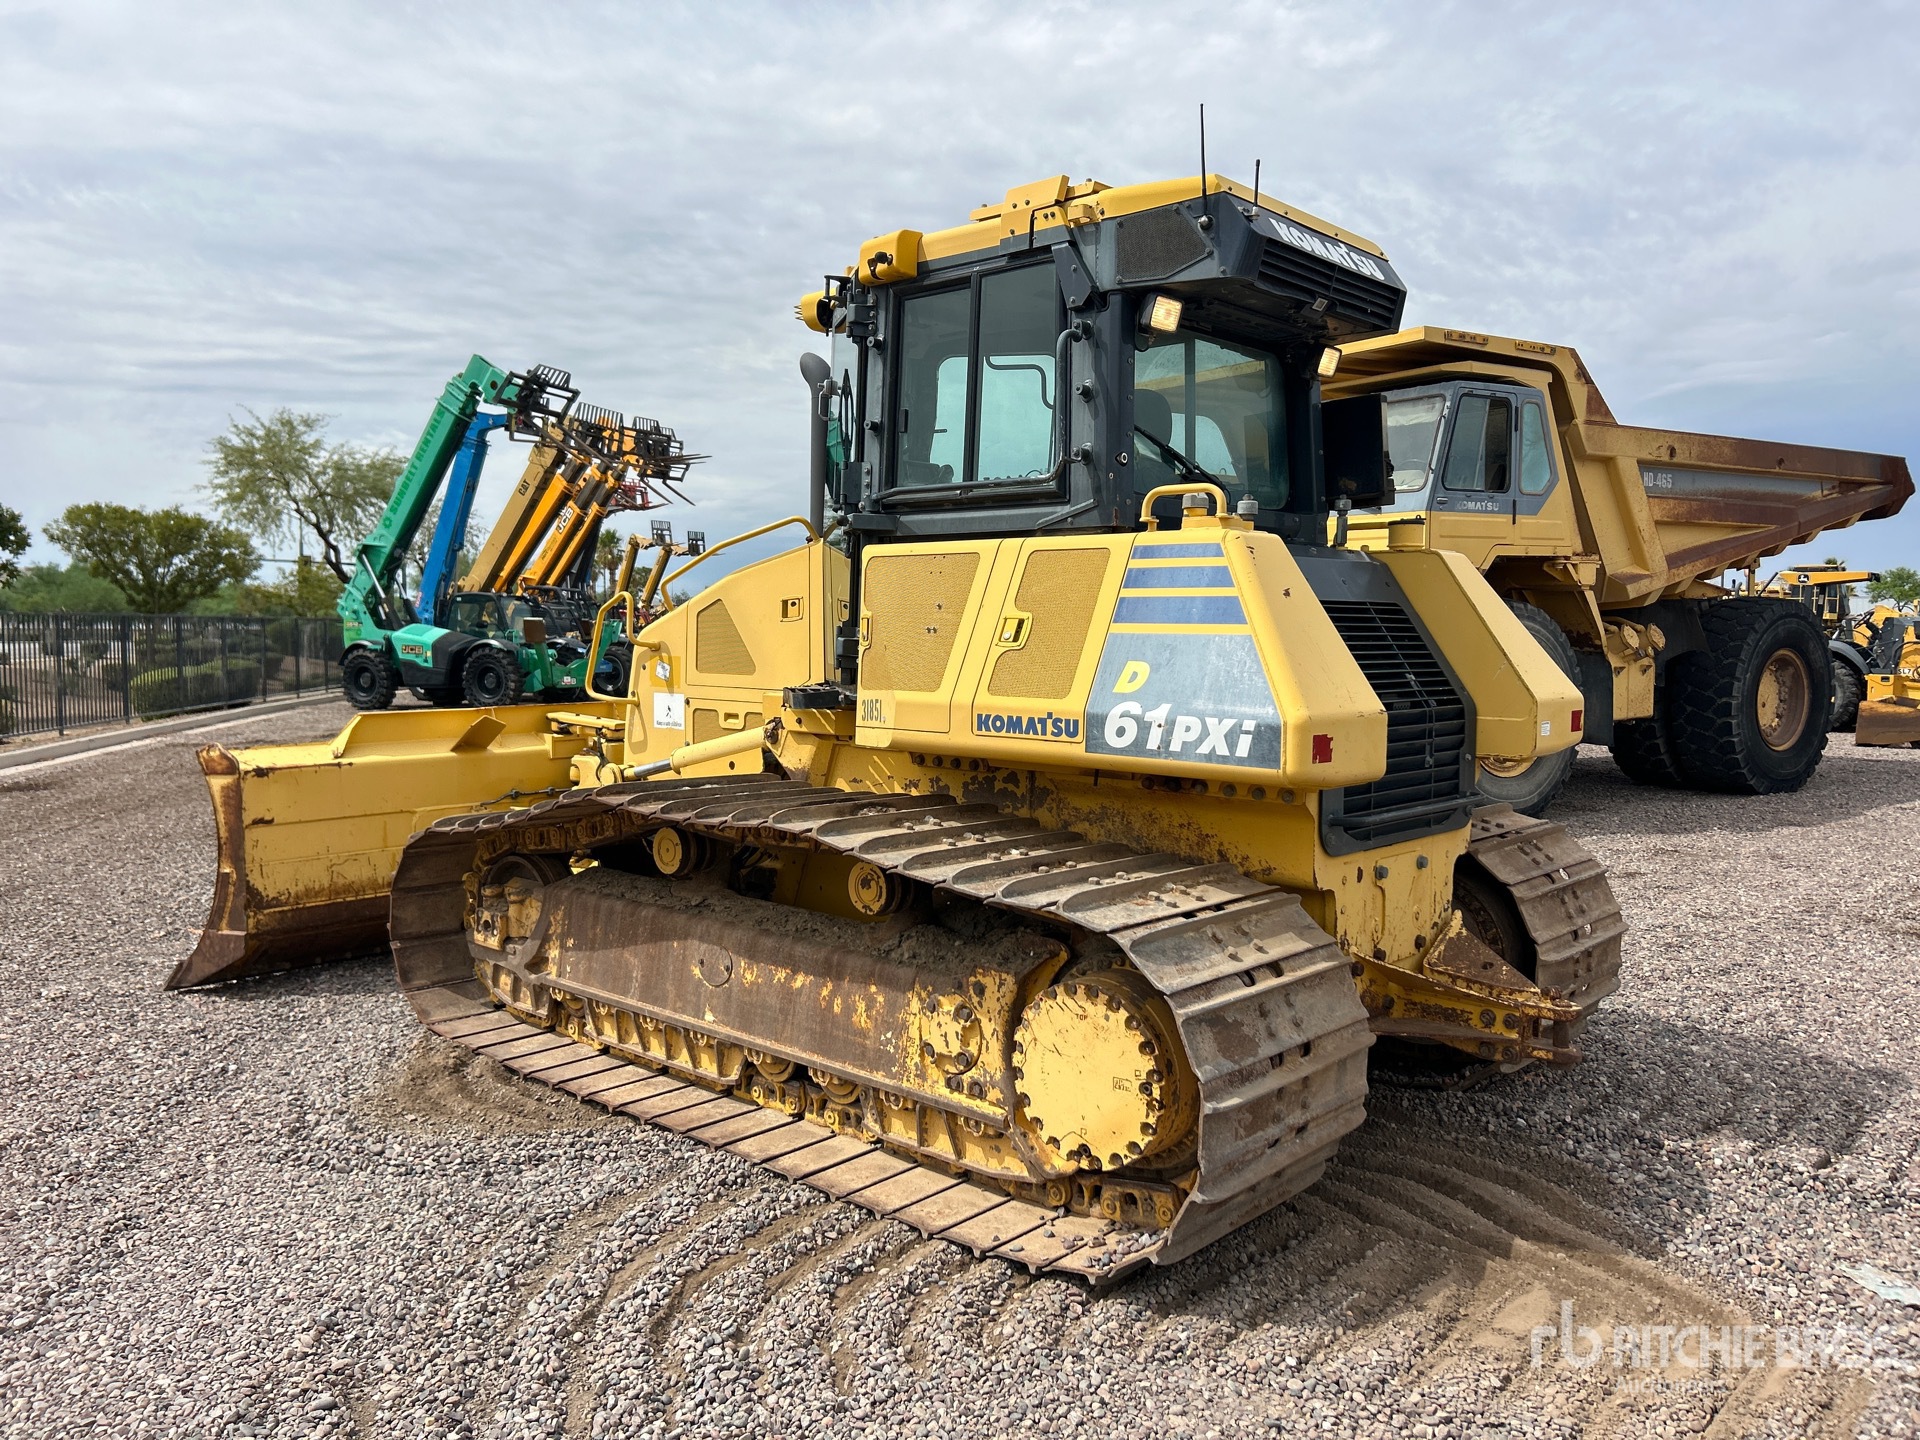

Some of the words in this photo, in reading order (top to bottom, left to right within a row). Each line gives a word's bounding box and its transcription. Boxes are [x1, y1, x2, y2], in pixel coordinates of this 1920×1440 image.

[1268, 216, 1385, 281] KOMATSU
[389, 461, 419, 515] SUNBELT
[415, 408, 446, 462] RENTALS
[518, 478, 531, 497] CAT
[1643, 471, 1673, 489] HD-465
[1455, 500, 1500, 511] KOMATSU
[556, 506, 574, 534] JCB
[402, 645, 423, 654] JCB
[1112, 660, 1151, 693] D
[976, 711, 1080, 739] KOMATSU
[1103, 701, 1257, 761] 61PXi
